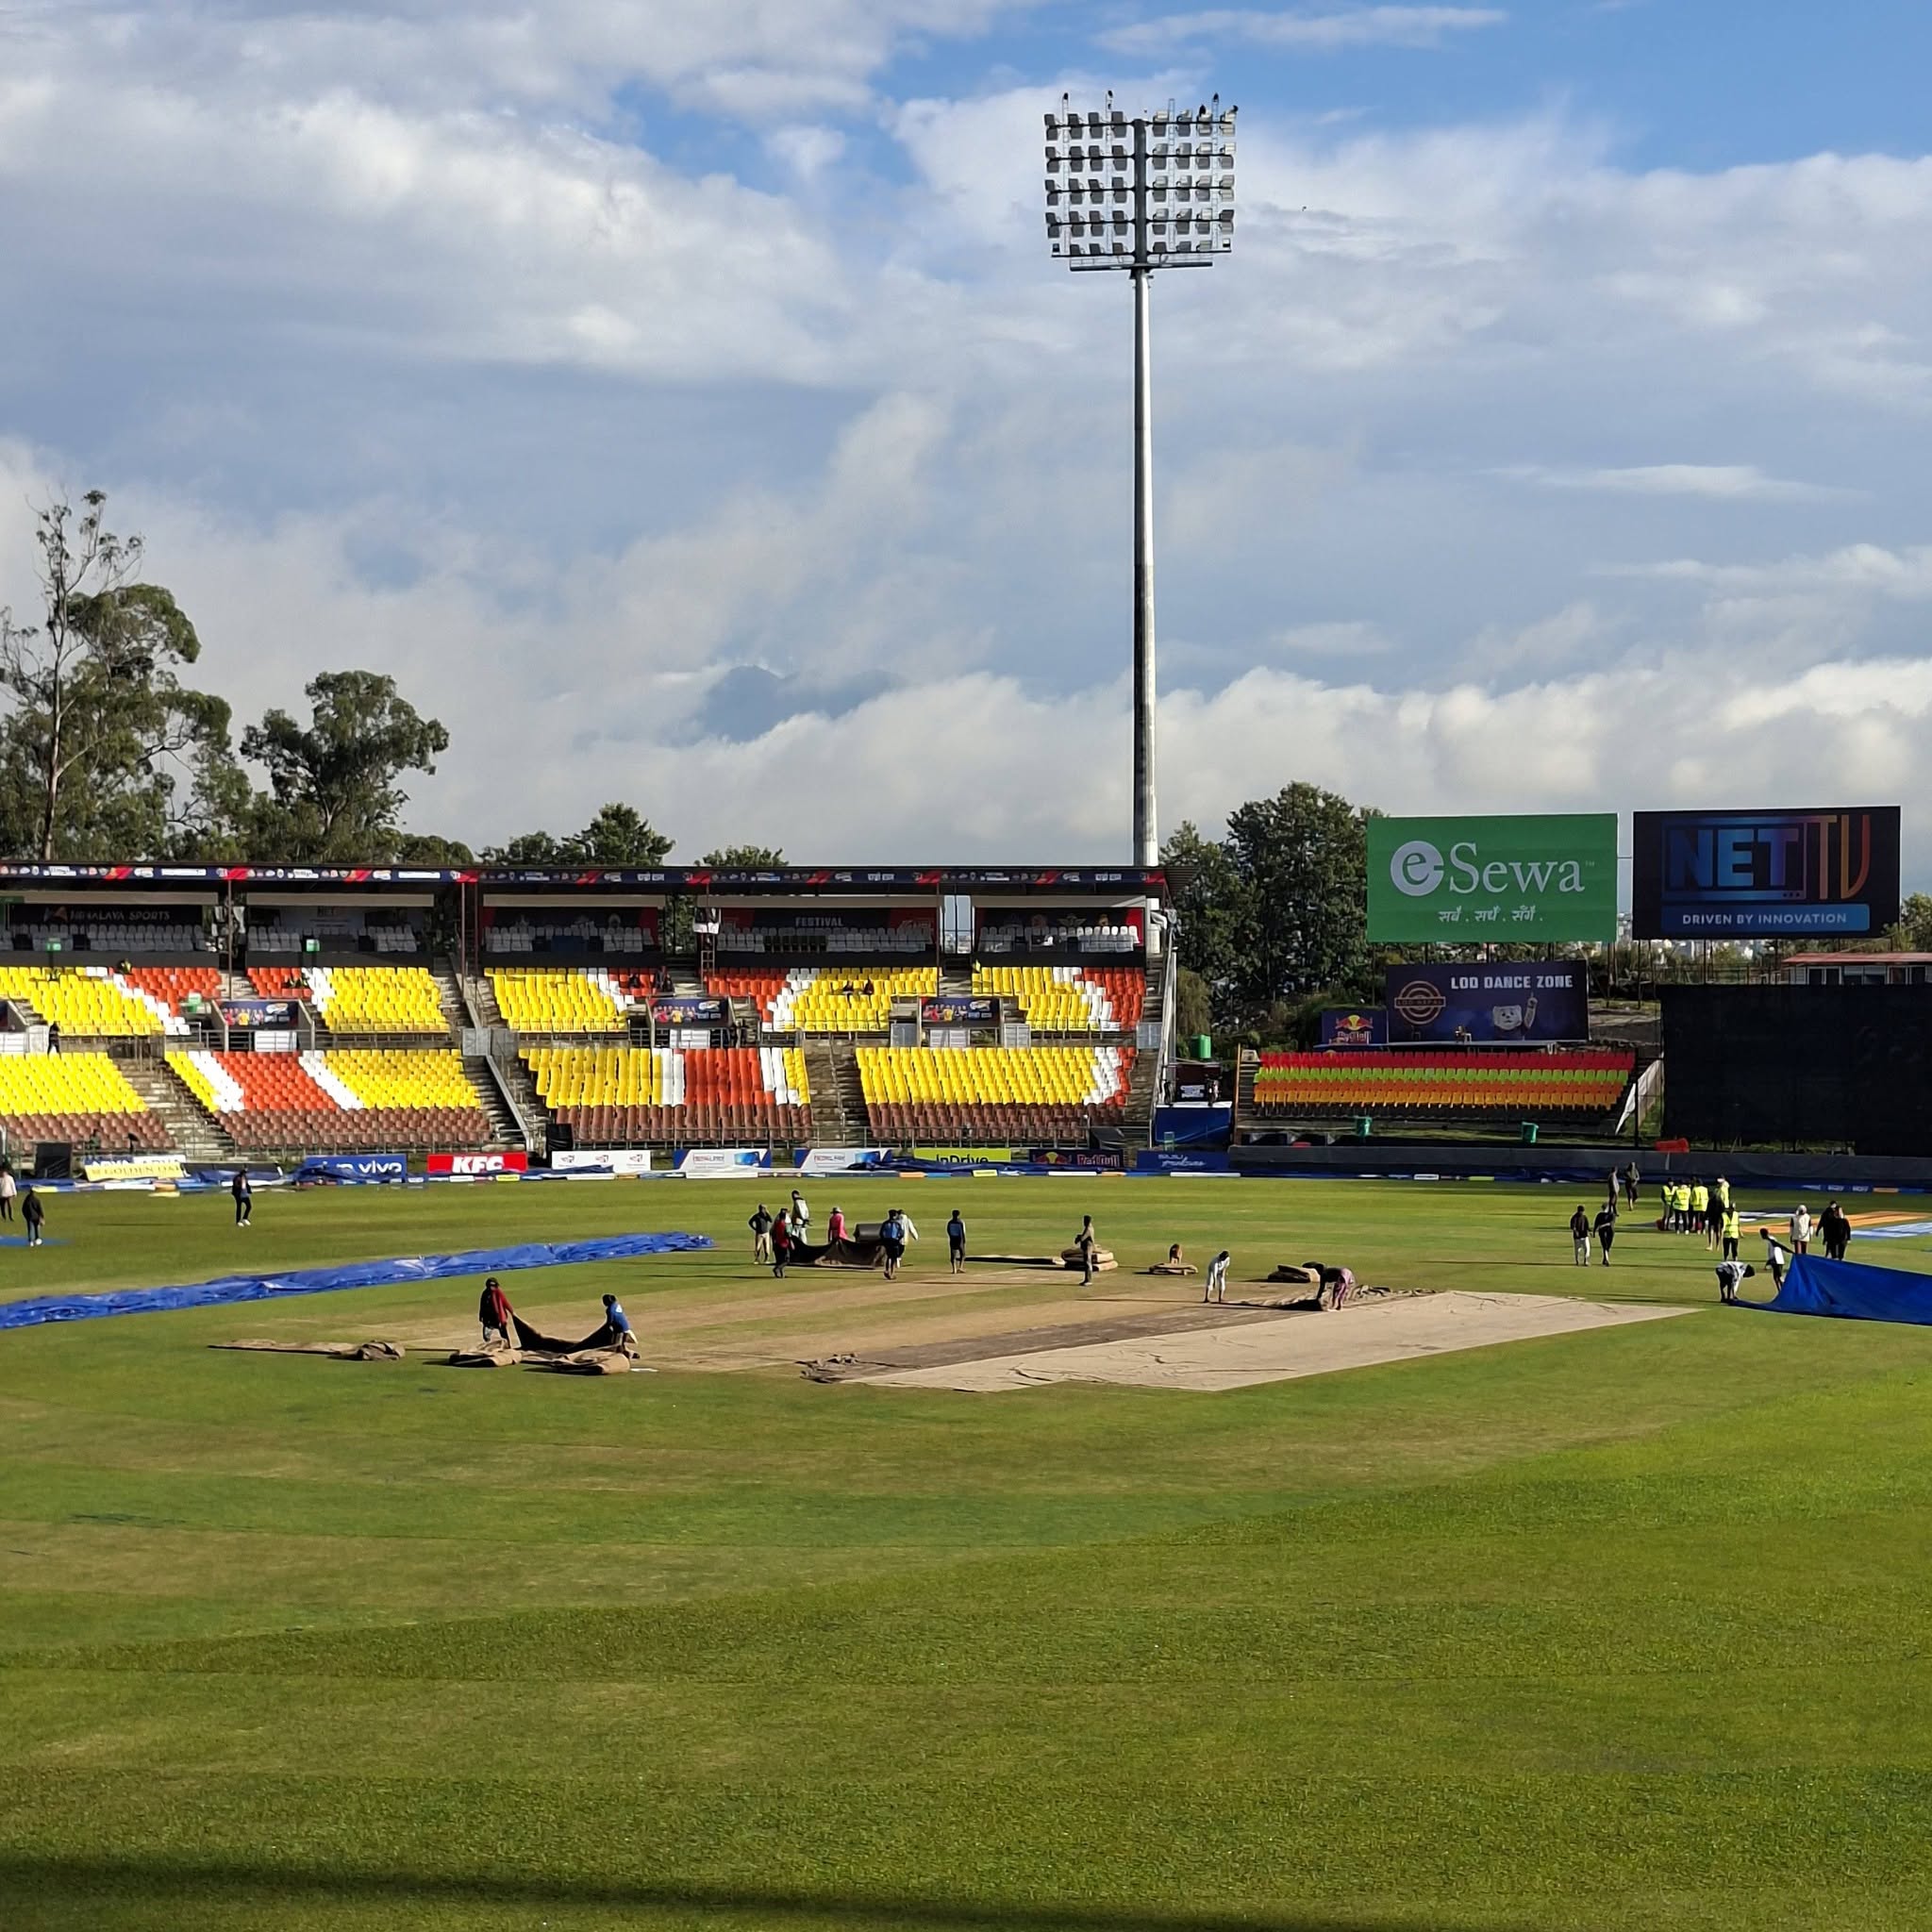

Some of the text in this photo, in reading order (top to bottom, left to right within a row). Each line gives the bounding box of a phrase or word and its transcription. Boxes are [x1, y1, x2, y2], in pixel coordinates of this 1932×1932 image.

[128, 910, 170, 921] SPORTS
[795, 917, 844, 927] FESTIVAL
[1682, 912, 1847, 925] DRIVEN BY INNOVATION
[1484, 975, 1531, 989] DANCE
[1537, 974, 1574, 989] ZONE
[358, 1159, 403, 1174] vivo
[452, 1156, 504, 1174] KFC
